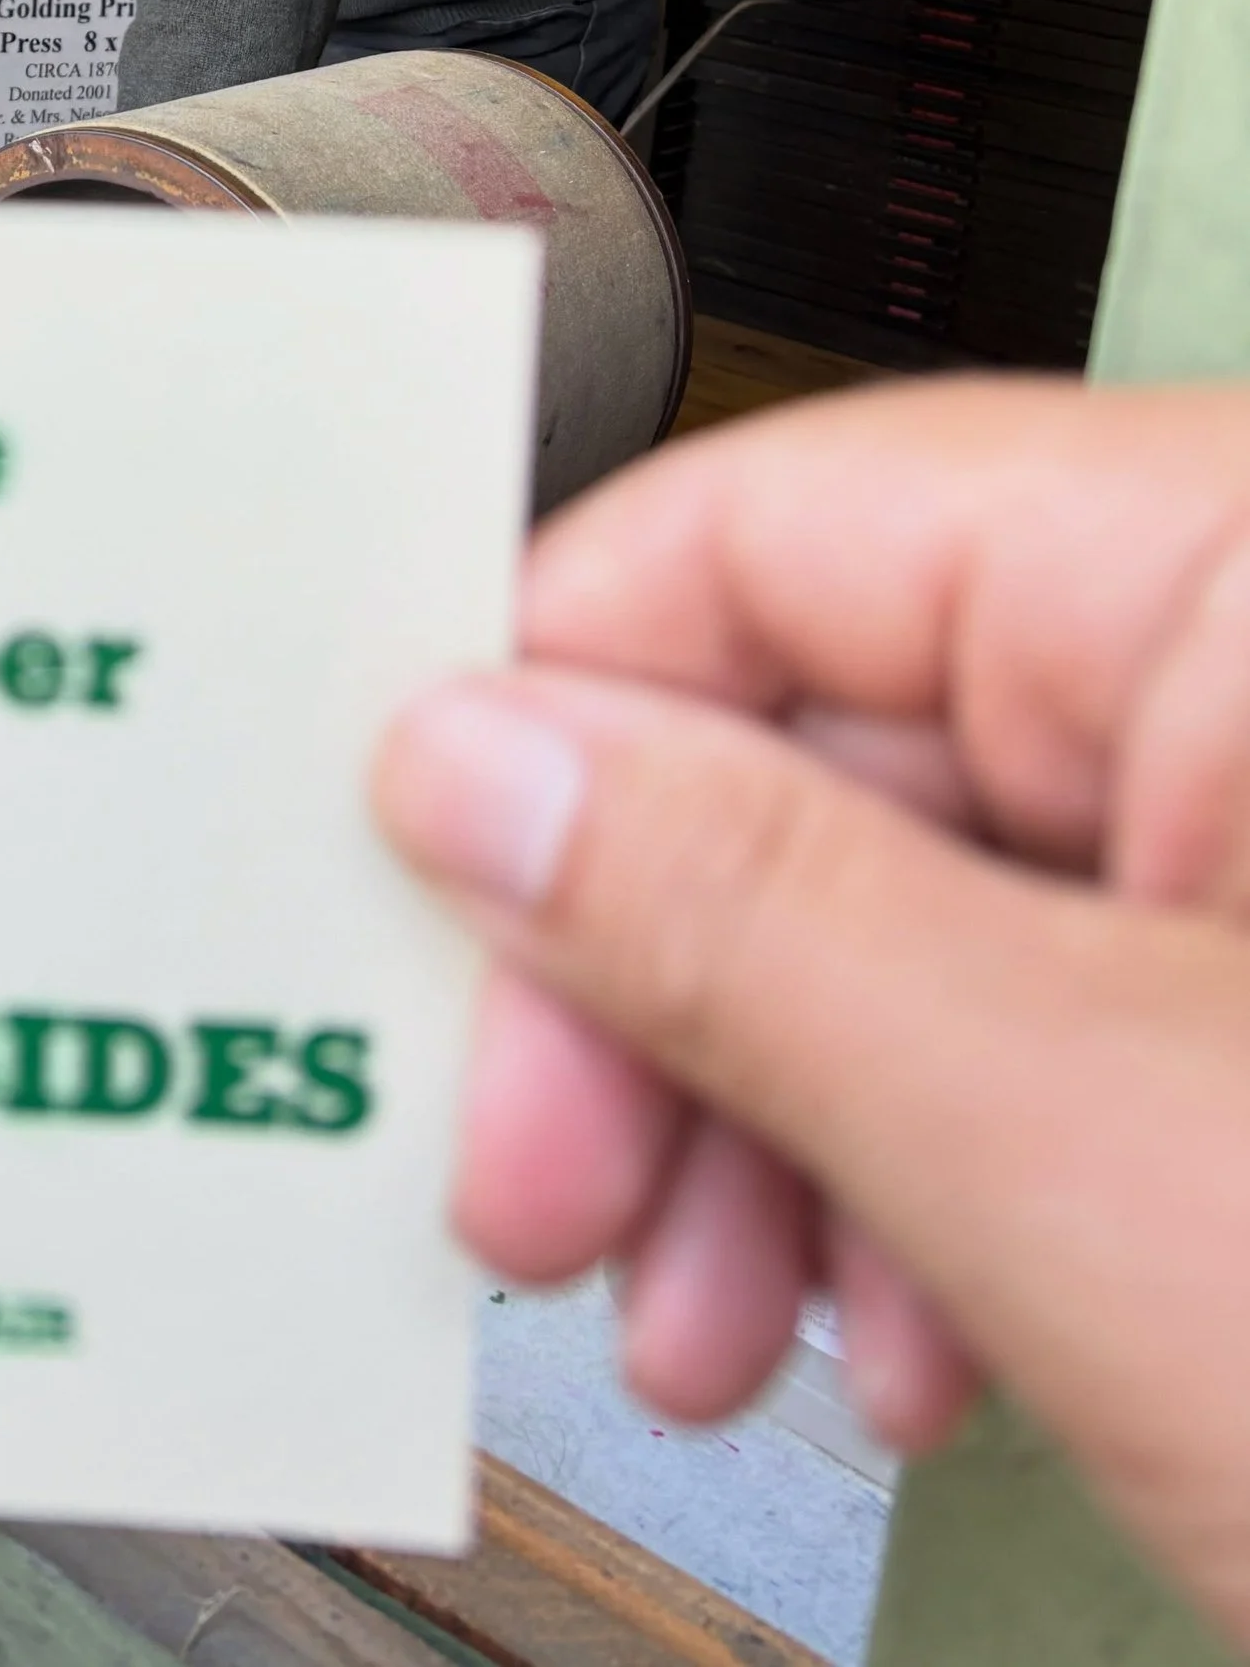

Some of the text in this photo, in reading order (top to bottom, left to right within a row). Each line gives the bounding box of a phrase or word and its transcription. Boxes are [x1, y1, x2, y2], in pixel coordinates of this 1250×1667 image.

[0, 30, 119, 54] Press 8 x
[24, 62, 82, 79] CIRCA
[8, 85, 112, 102] Donated 2001
[10, 110, 26, 125] &
[30, 109, 64, 124] Mrs.
[69, 107, 116, 124] Nelso
